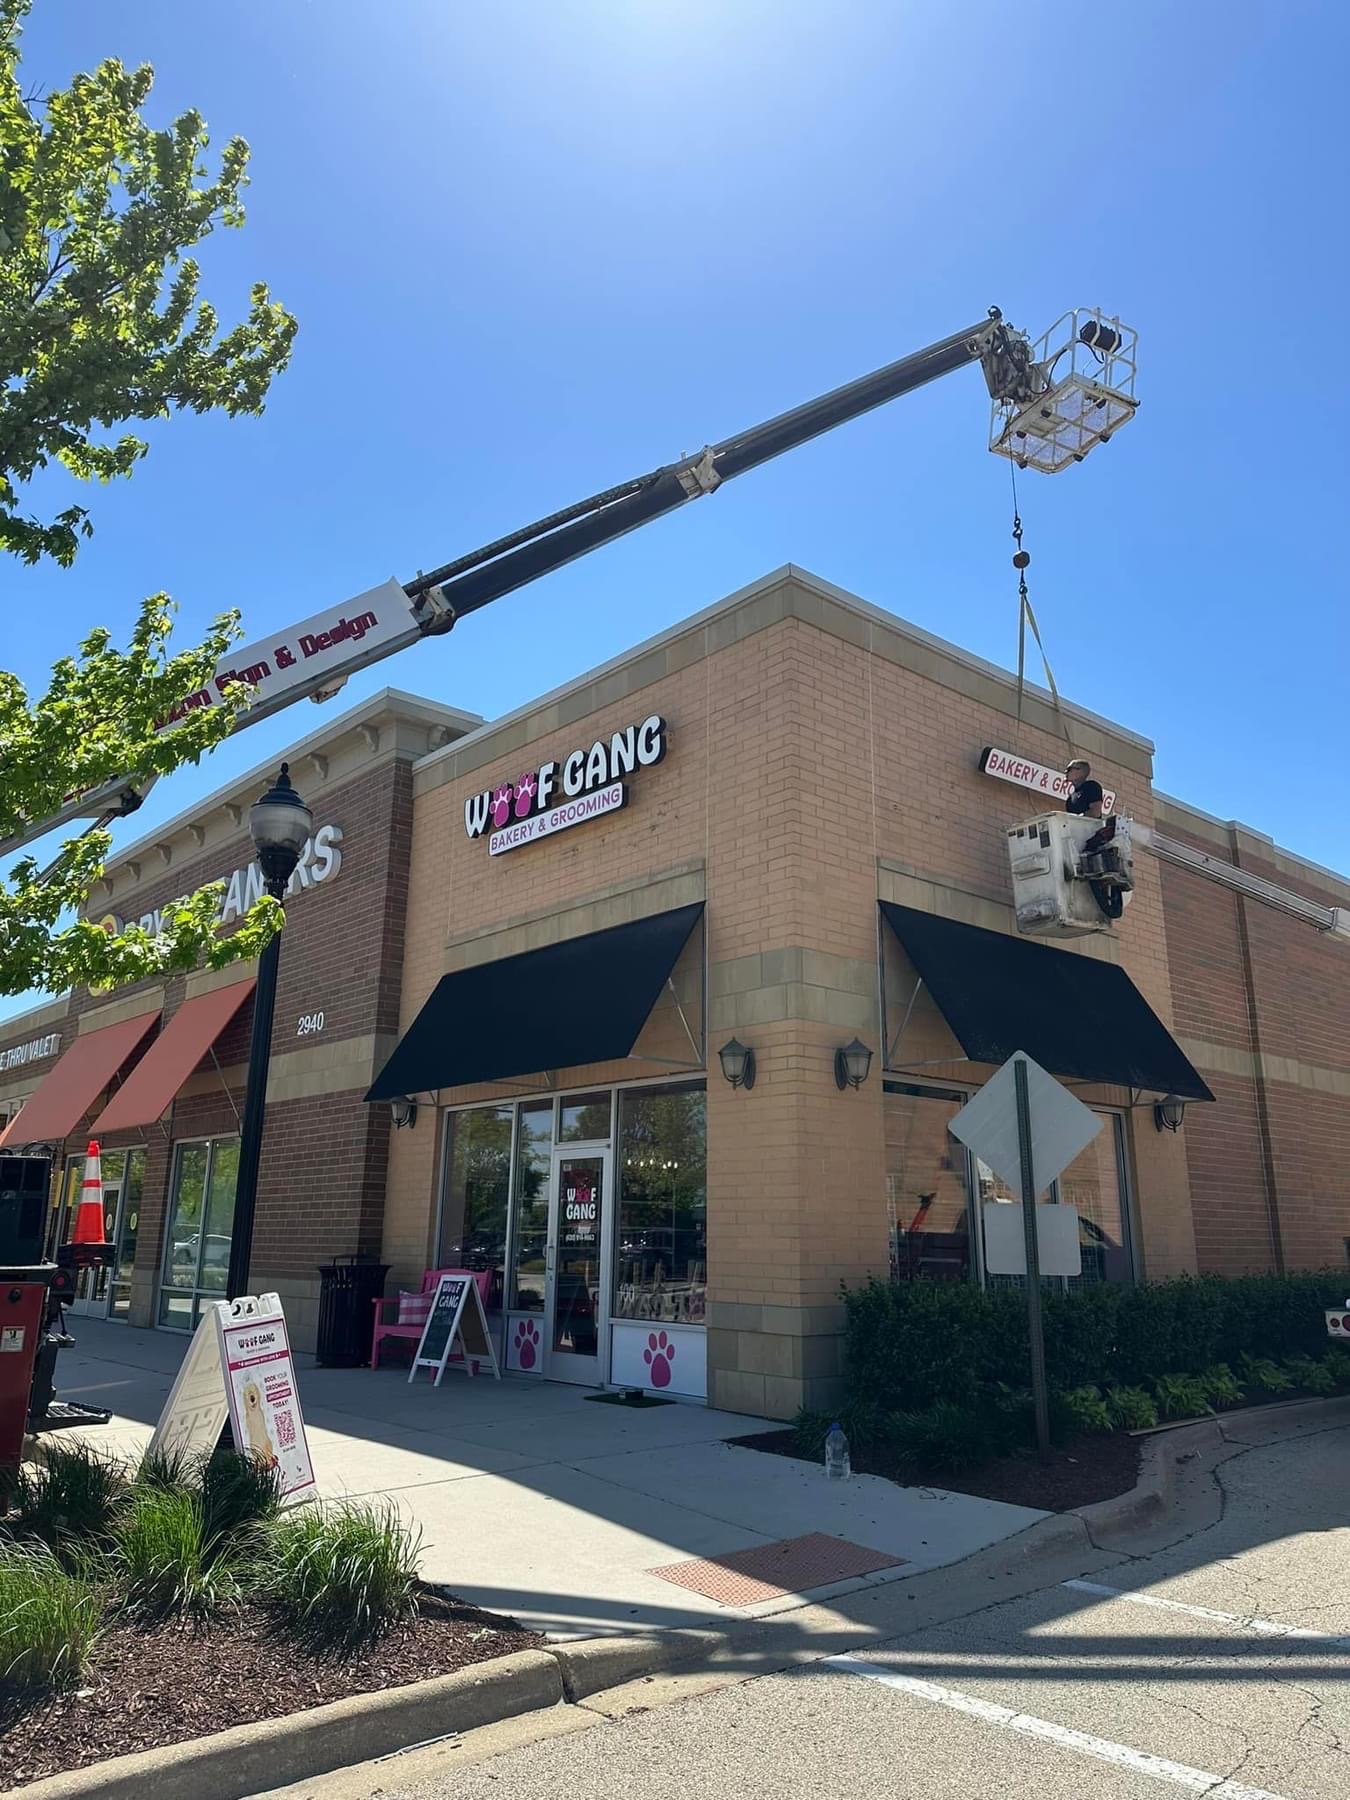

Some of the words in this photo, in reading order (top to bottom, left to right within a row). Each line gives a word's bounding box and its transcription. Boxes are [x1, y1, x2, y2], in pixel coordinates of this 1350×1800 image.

[273, 645, 297, 670] &
[297, 611, 379, 659] Design
[562, 714, 665, 798] GANG
[988, 753, 1039, 784] BAKERY
[1040, 772, 1049, 789] &
[490, 821, 536, 851] BAKERY
[538, 817, 547, 833] &
[550, 787, 621, 828] GROOMING
[297, 1011, 324, 1036] 2940
[7, 1045, 28, 1069] THRU
[29, 1033, 62, 1061] VALET
[566, 1203, 596, 1220] GANG
[439, 1295, 460, 1308] GANG
[258, 1332, 276, 1345] GANG
